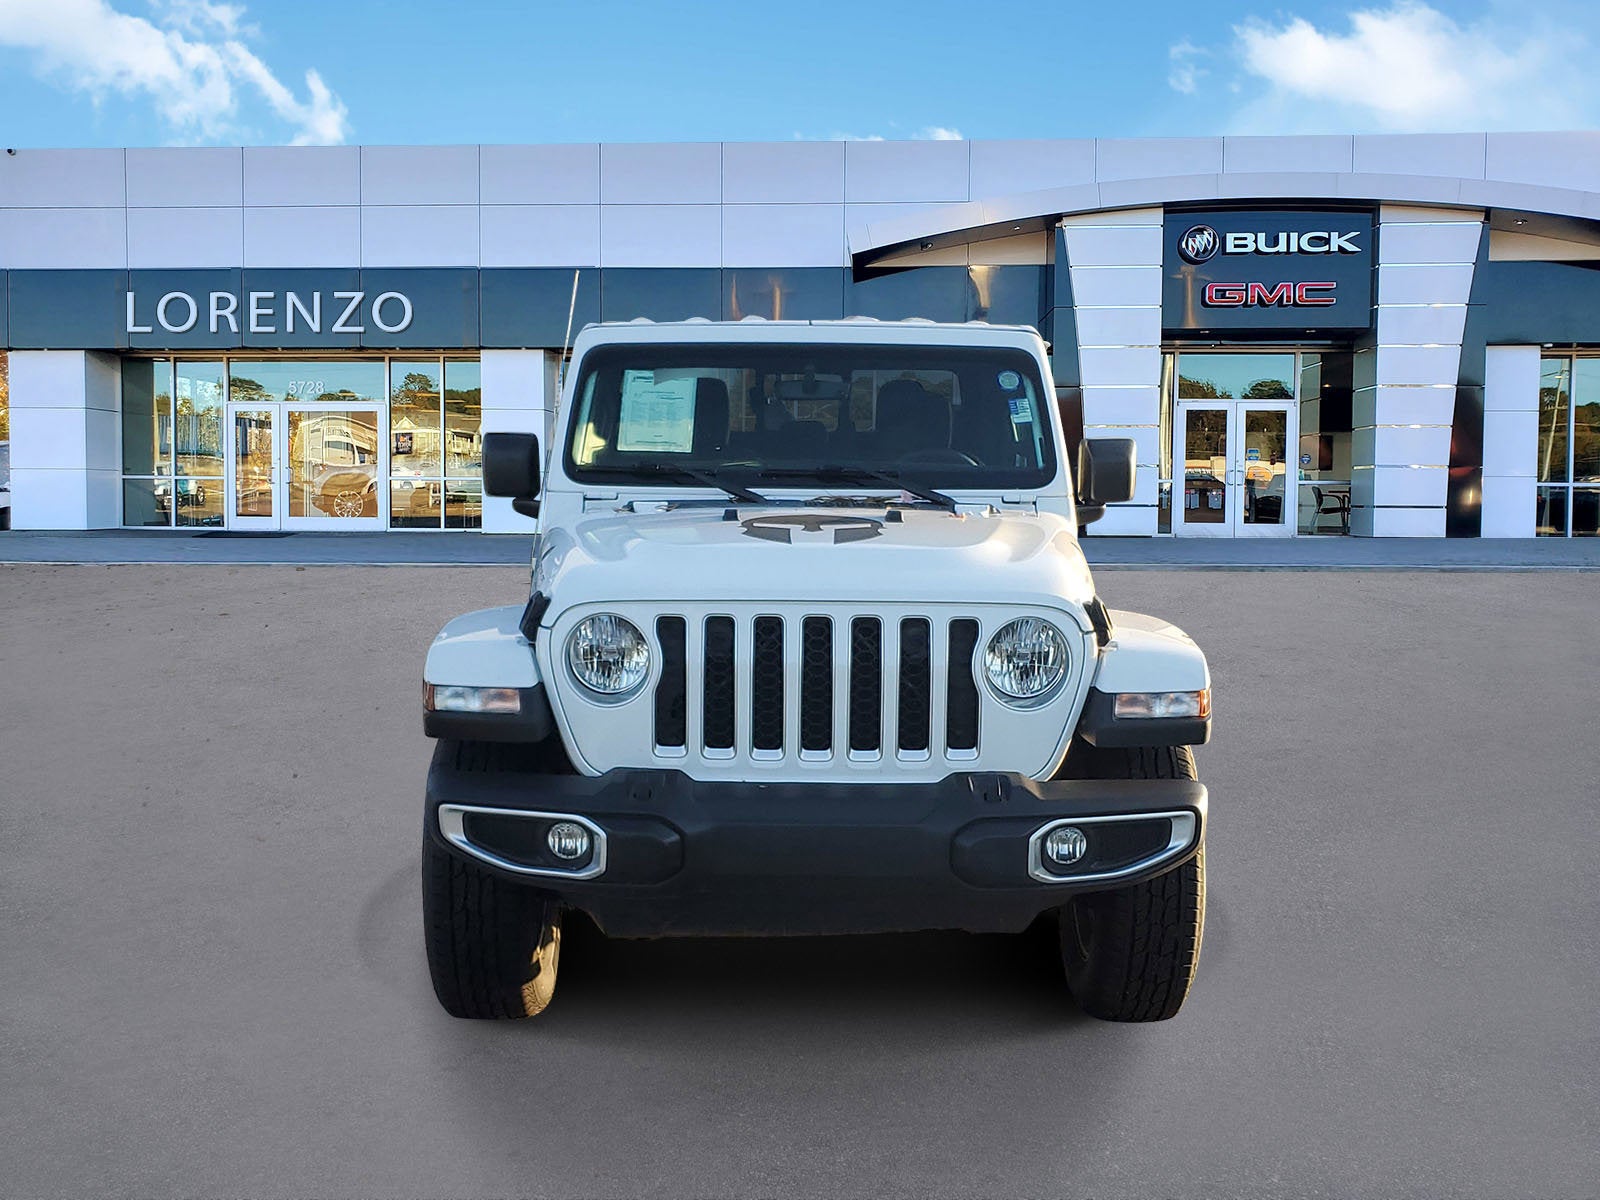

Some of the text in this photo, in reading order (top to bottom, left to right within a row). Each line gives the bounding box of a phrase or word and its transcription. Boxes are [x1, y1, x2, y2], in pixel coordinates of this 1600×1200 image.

[1224, 231, 1362, 254] BUICK
[1204, 281, 1337, 306] GMC
[126, 291, 414, 333] LORENZO
[288, 380, 325, 394] 5728
